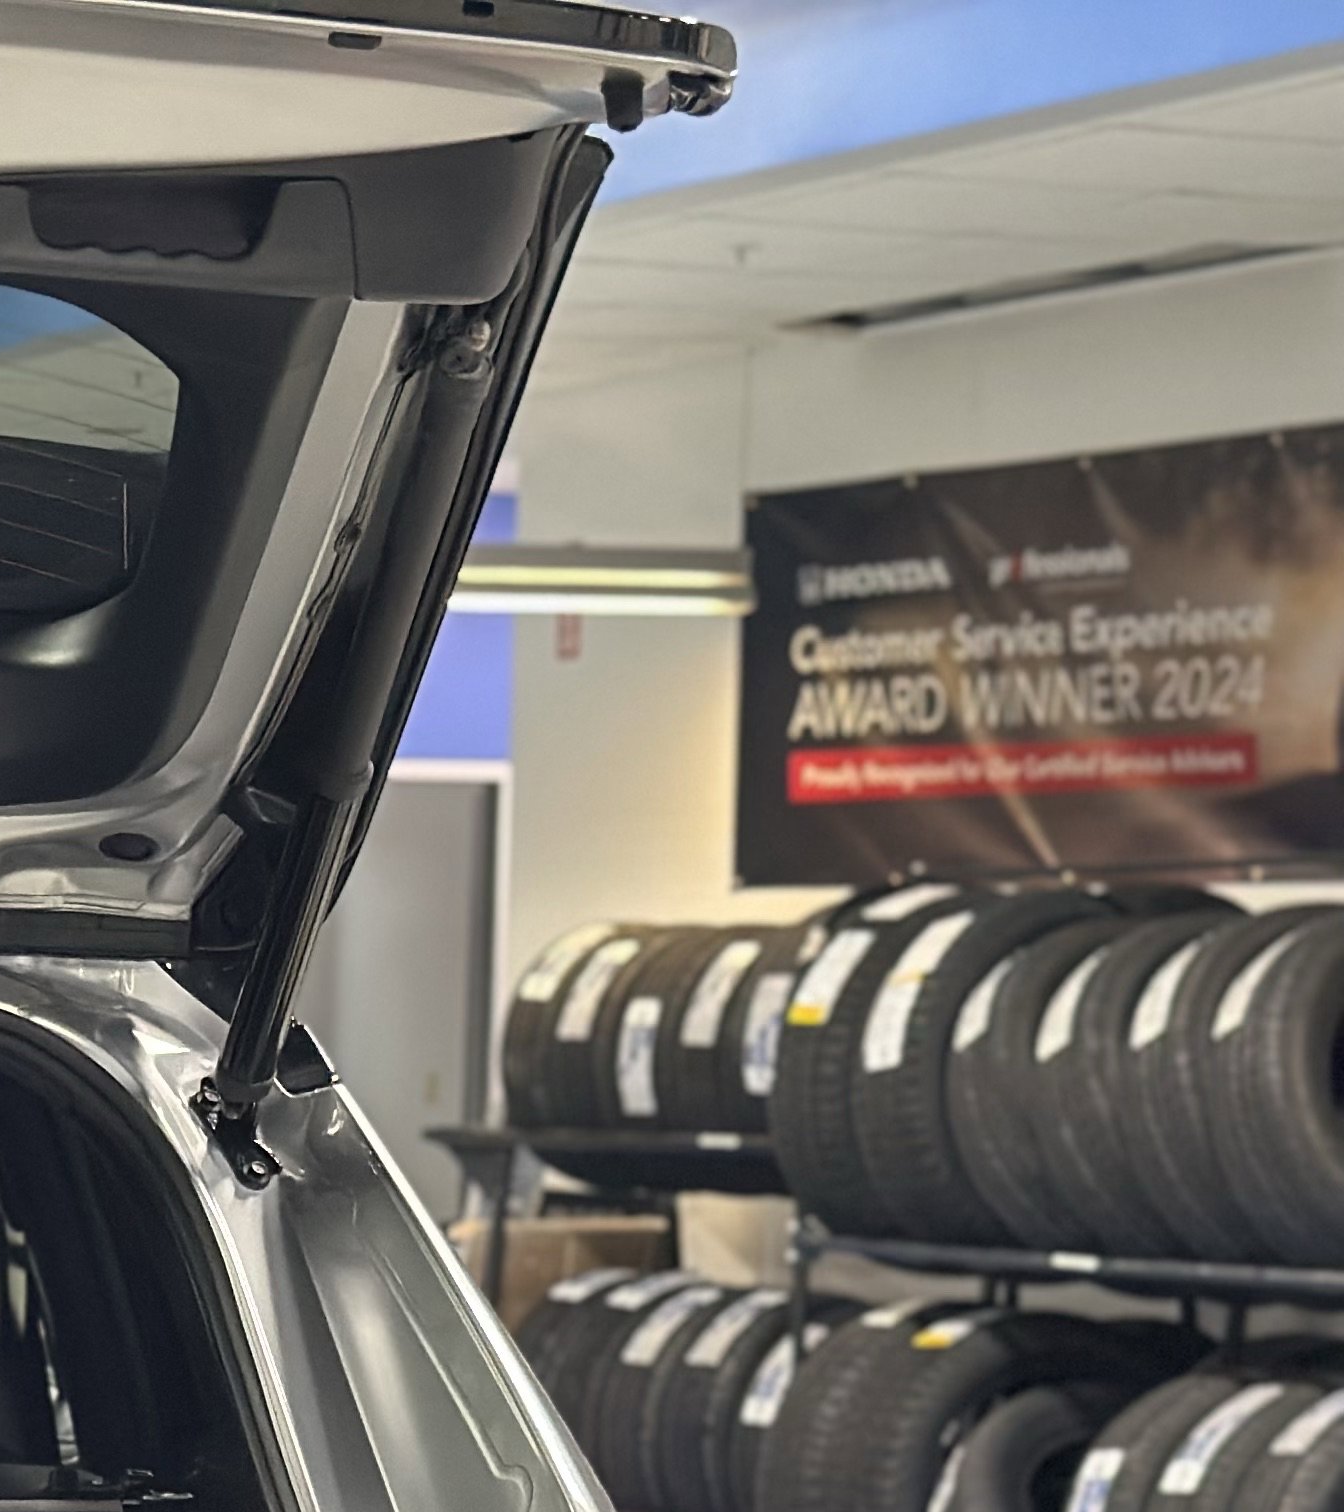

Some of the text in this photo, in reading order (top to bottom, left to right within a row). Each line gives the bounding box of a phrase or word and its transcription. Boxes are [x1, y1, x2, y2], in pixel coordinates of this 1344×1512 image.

[823, 557, 951, 599] HONDA
[789, 598, 1274, 675] Customer Service Experience
[787, 655, 1267, 740] AWARD WINNER 2024
